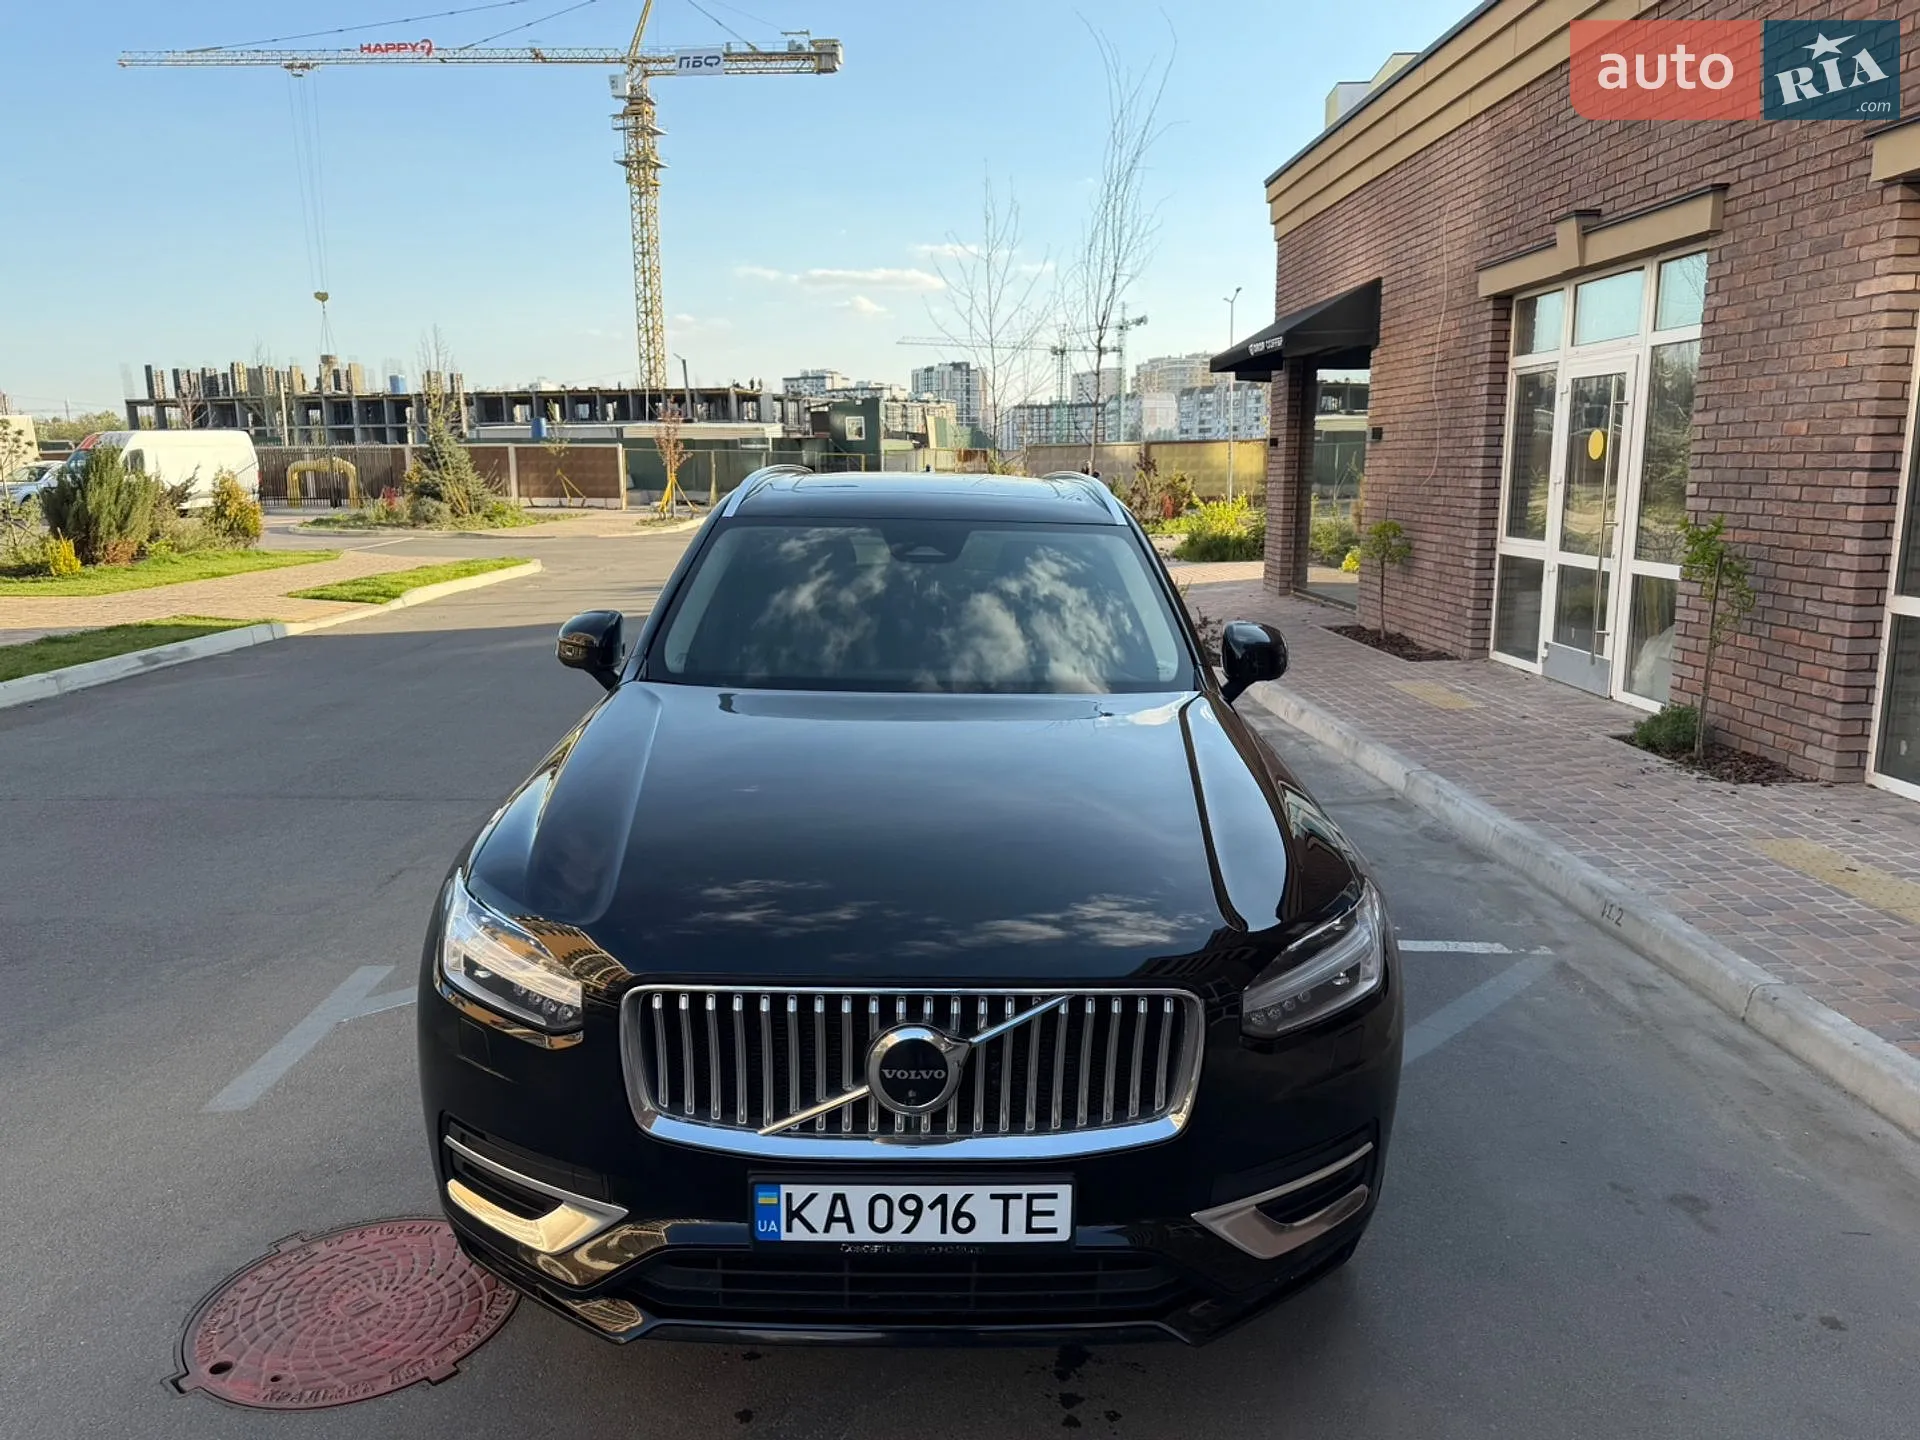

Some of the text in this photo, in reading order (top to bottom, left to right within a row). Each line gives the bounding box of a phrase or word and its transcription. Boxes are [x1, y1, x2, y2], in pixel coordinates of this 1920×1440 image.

[360, 42, 419, 53] HAPPY
[678, 56, 721, 69] ПБФ
[881, 1069, 946, 1080] VOLVO
[785, 1193, 1059, 1235] KA 0916 TE
[758, 1220, 778, 1233] UA
